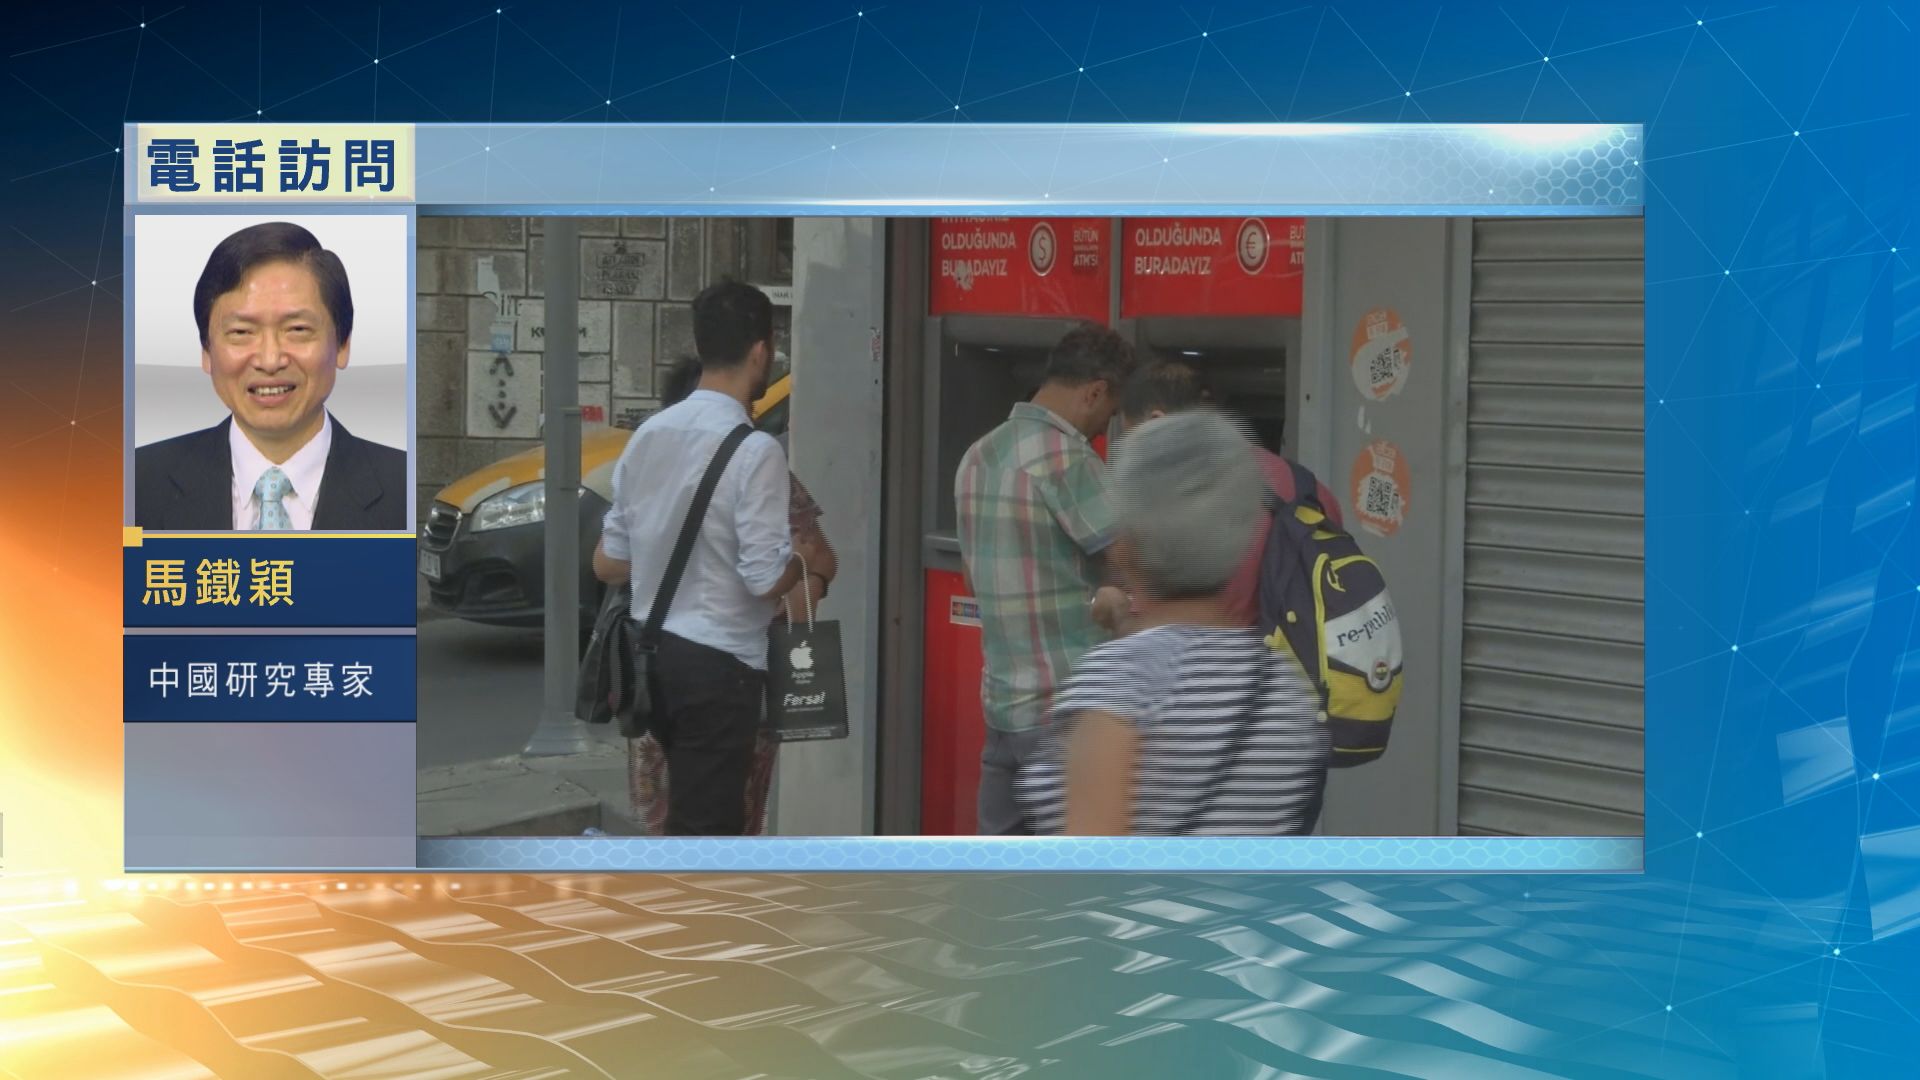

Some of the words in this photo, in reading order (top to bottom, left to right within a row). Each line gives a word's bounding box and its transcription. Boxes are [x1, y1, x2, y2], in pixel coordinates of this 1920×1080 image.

[942, 228, 1017, 249] OLDUĞUNDA
[1136, 222, 1222, 246] OLDUĞUNDA
[1135, 256, 1211, 275] BURADAYIZ
